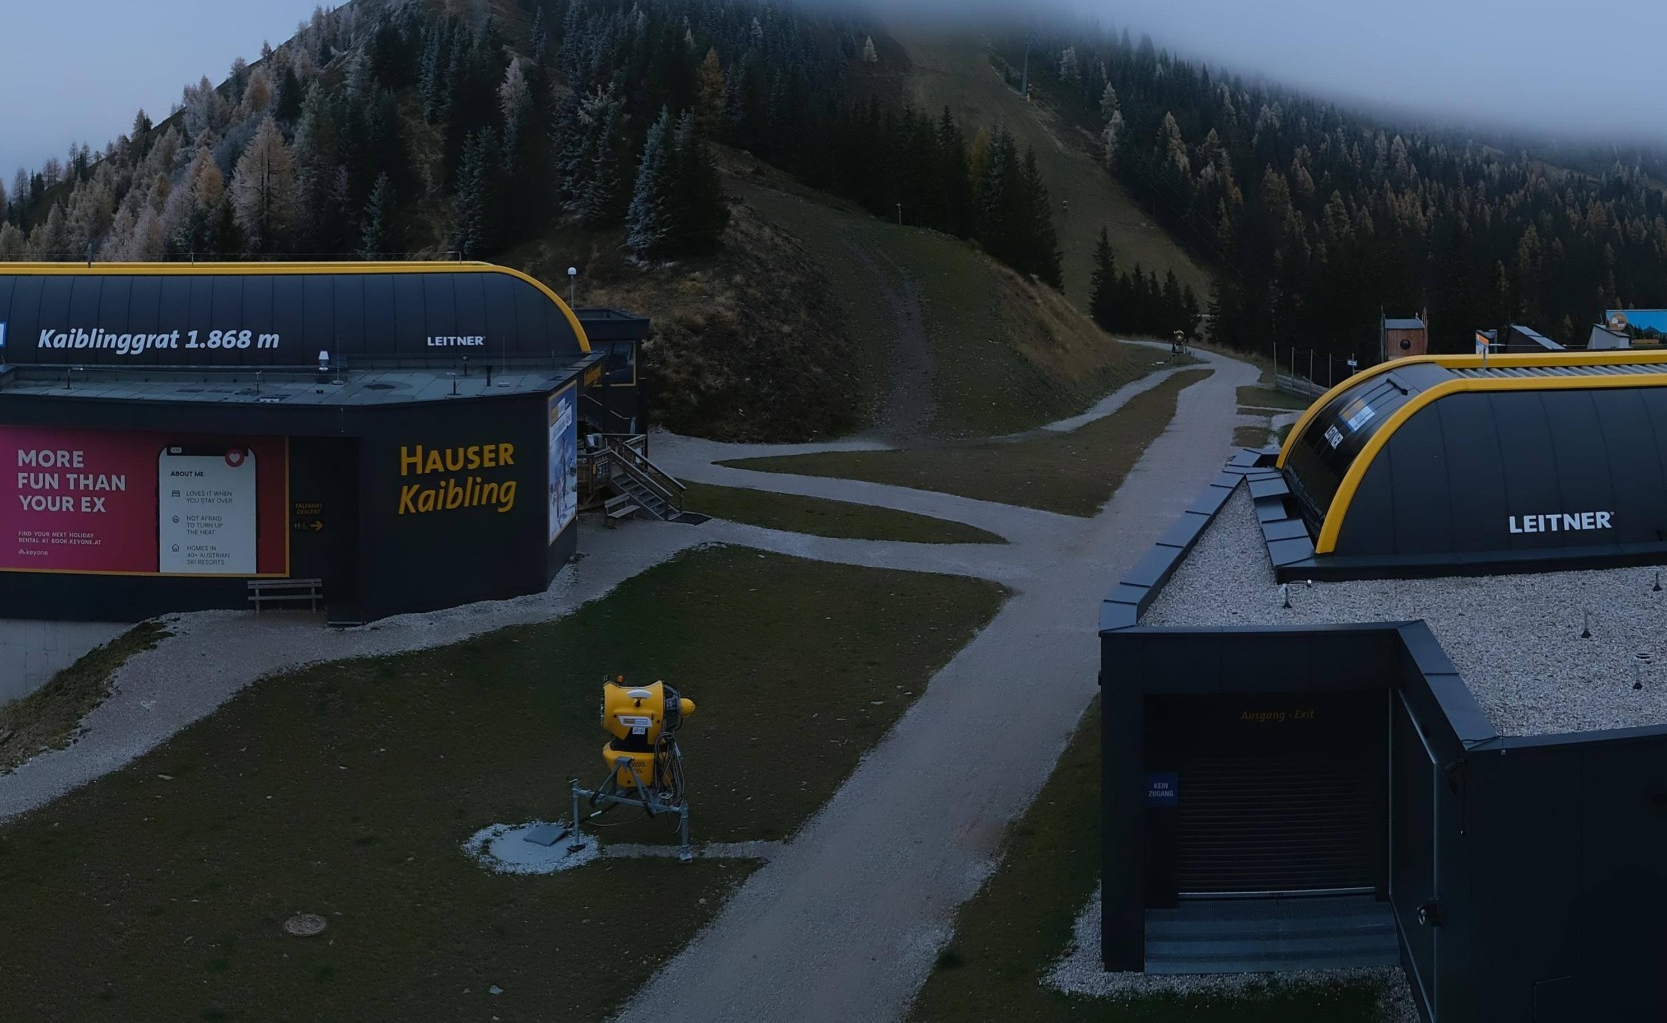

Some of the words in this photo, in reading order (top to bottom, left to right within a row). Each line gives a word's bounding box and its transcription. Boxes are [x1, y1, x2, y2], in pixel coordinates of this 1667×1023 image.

[38, 328, 179, 355] Kaiblinggrat
[184, 329, 251, 349] 1.868
[256, 333, 280, 349] m
[17, 449, 85, 468] MORE
[401, 442, 515, 476] HAUSER
[17, 472, 59, 490] FUN
[66, 473, 126, 491] THAN
[18, 495, 75, 512] YOUR
[81, 496, 106, 513] EX
[398, 477, 517, 515] Kaibling
[26, 548, 49, 557] keyone
[1240, 710, 1286, 723] Ausgang
[1294, 708, 1315, 719] Exit
[1148, 790, 1174, 798] ZUGANG
[1153, 782, 1169, 790] KEIN
